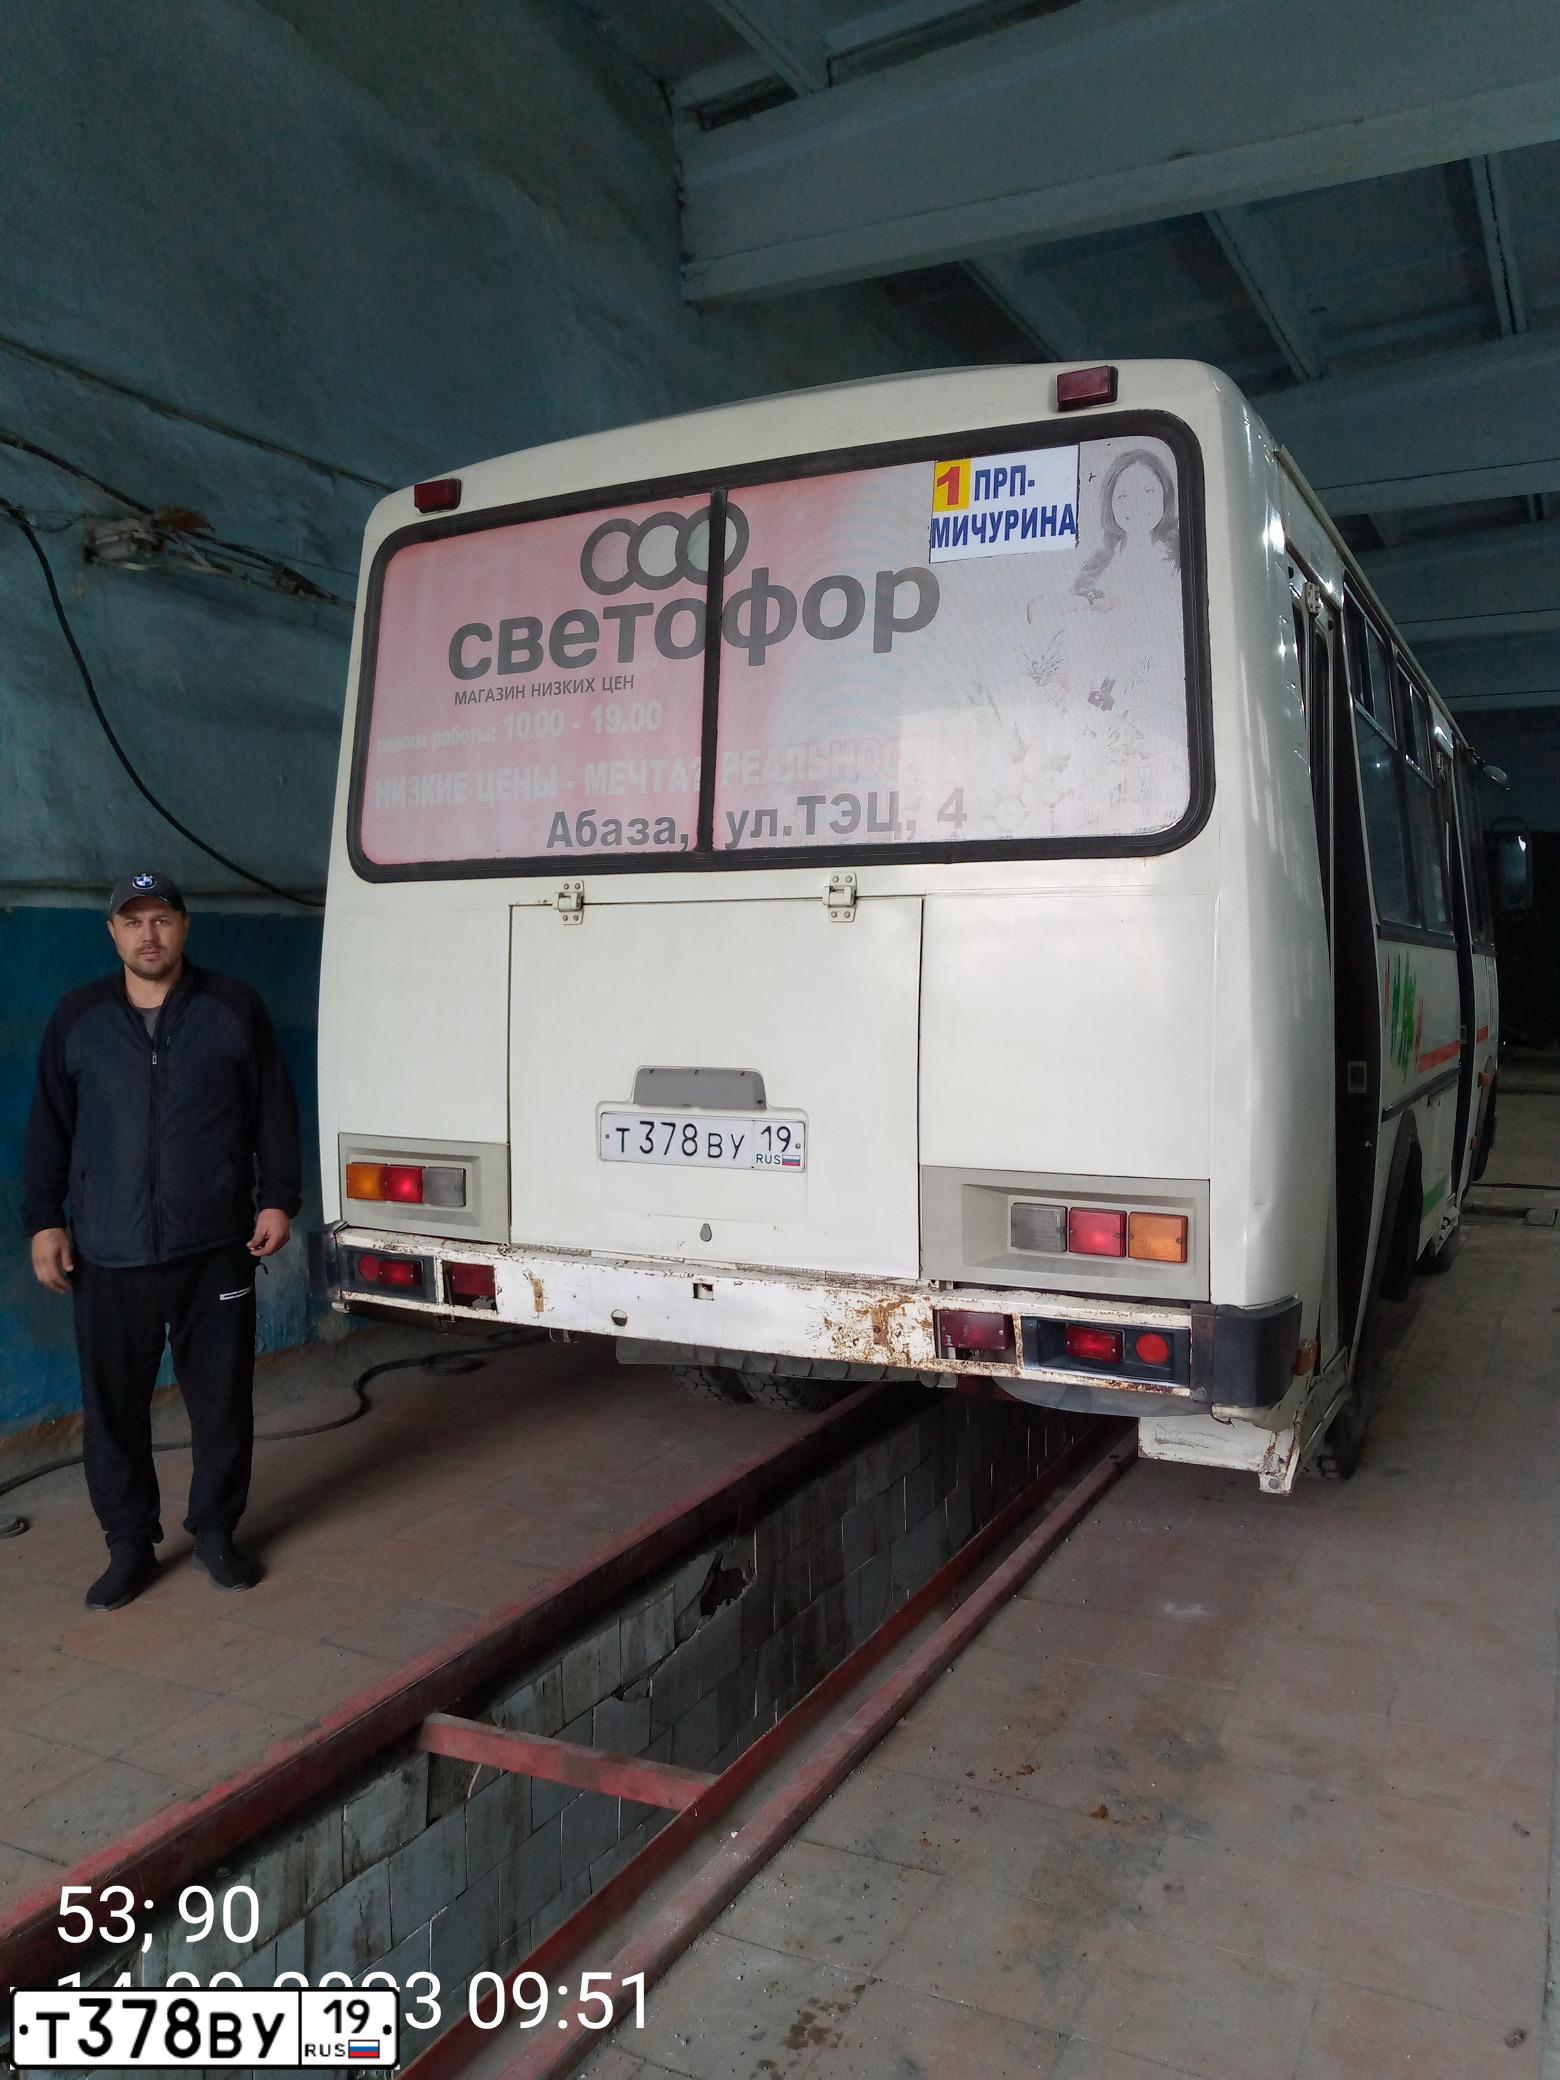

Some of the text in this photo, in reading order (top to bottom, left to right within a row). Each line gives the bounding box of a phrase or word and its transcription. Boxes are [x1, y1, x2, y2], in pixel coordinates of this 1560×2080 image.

[937, 464, 1036, 506] 1 ПРП-
[931, 503, 1076, 549] МИЧУРИНА
[454, 674, 634, 706] МАГАЗИН НИЗКИХ ЦЕН
[503, 707, 565, 741] 10.00
[591, 701, 662, 735] 19.00
[375, 770, 468, 809] НИЗКИЕ
[478, 764, 559, 808] ЦЕНЫ
[546, 808, 690, 852] Абаза,
[937, 787, 968, 829] 4
[756, 1153, 781, 1166] RUS
[760, 1125, 791, 1153] 19
